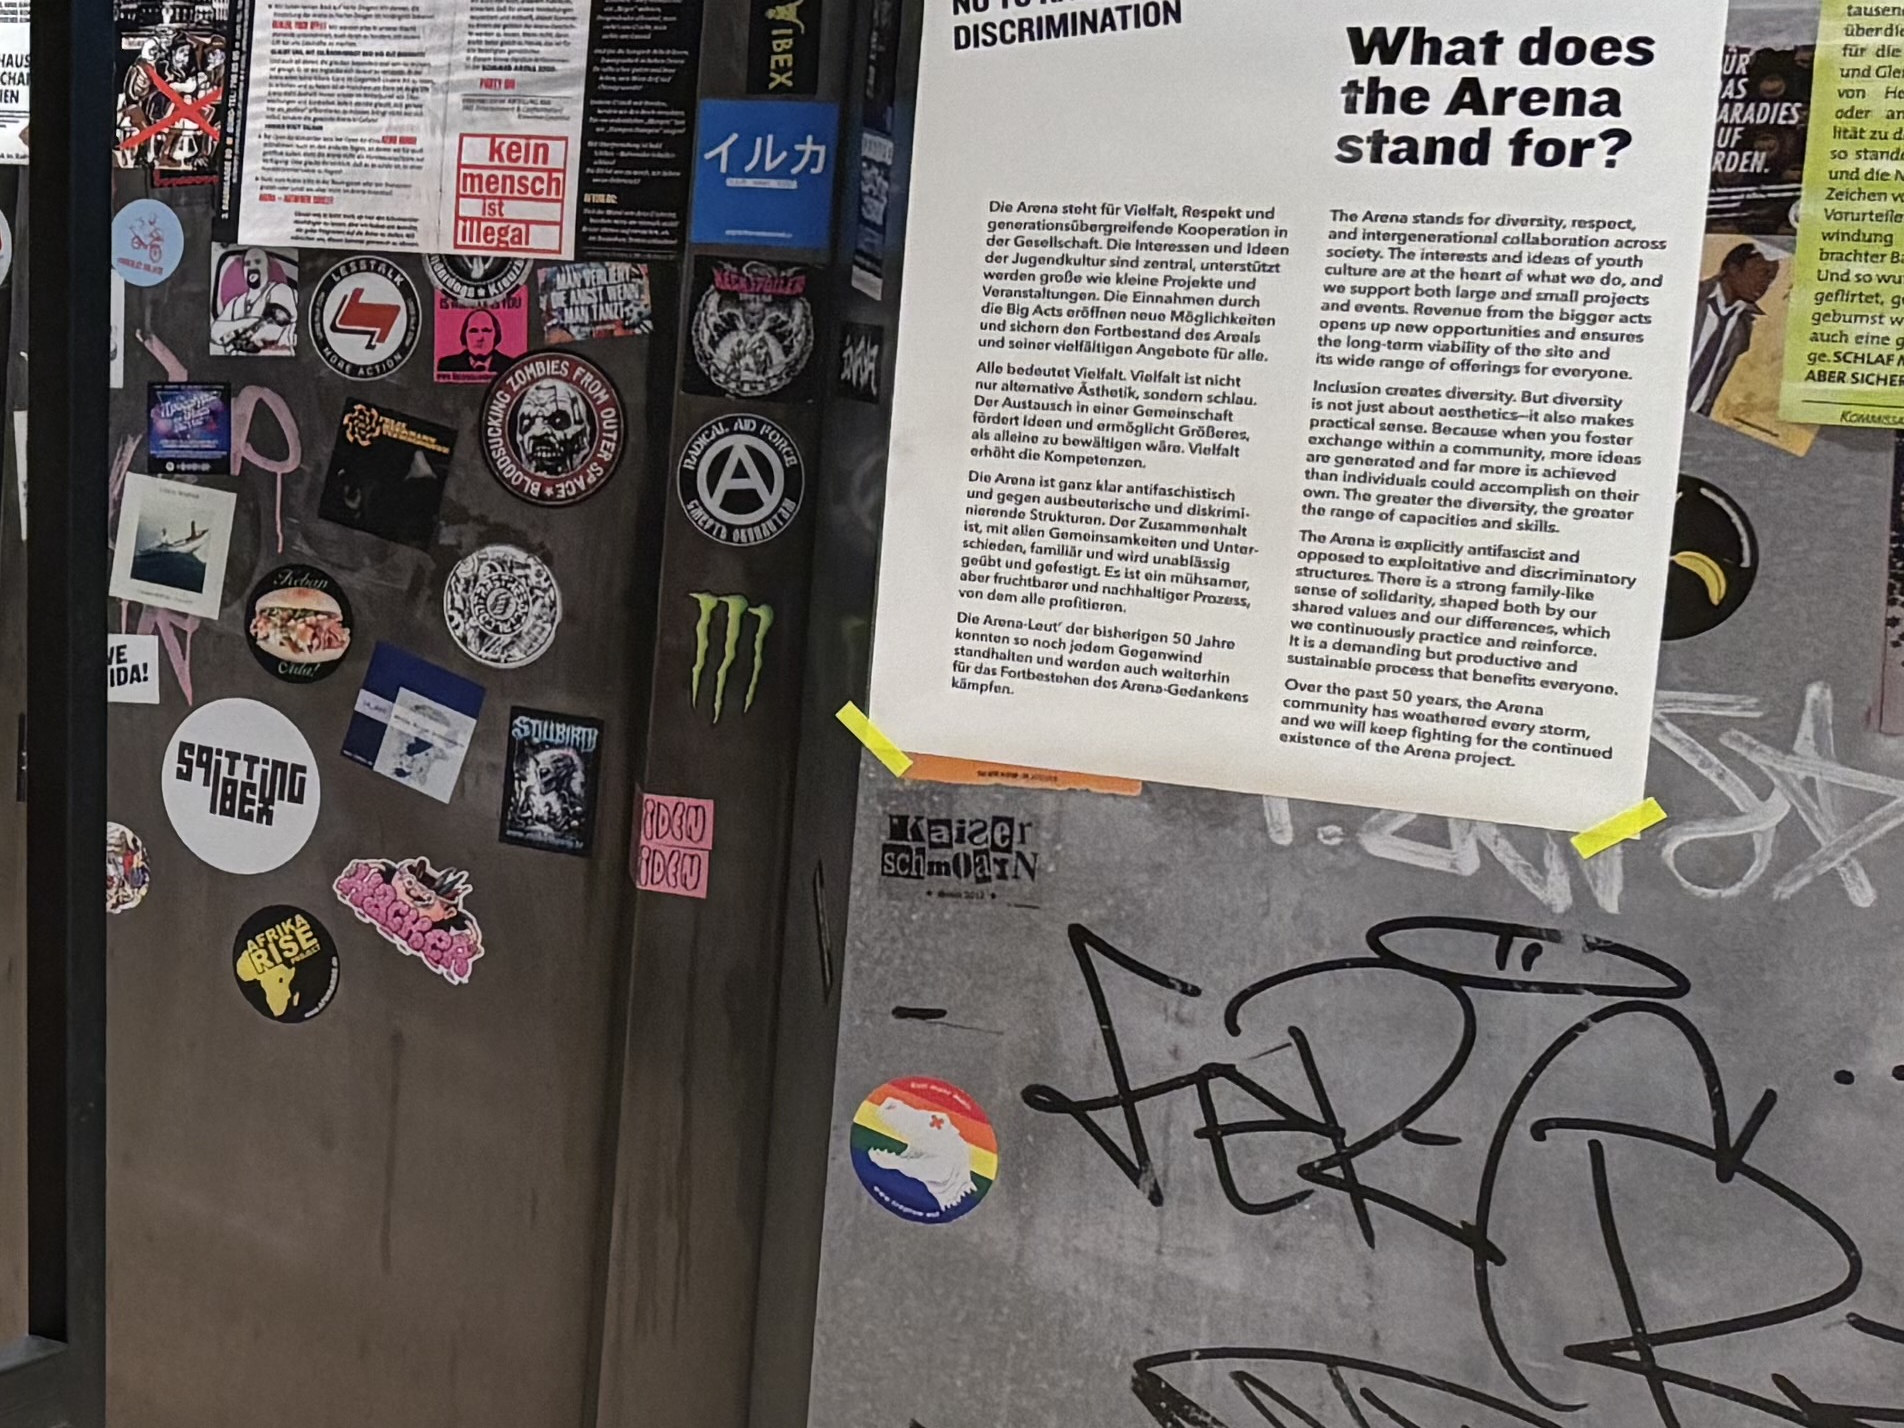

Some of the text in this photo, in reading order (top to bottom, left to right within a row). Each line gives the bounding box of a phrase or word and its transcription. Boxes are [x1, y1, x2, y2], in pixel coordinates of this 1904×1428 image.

[768, 28, 794, 90] IBEX
[1346, 26, 1656, 66] What does
[1341, 76, 1622, 117] the Arena
[489, 137, 549, 165] kein
[704, 132, 826, 174] イルカ
[1334, 127, 1633, 168] stand for?
[462, 170, 561, 196] mensch
[482, 200, 504, 216] ist
[1330, 209, 1636, 233] The Arena stands for diversity, respect,
[461, 221, 530, 247] illegal
[487, 359, 618, 499] BLOODSUCKING ZOMBIES FROM OUTER SPACE
[246, 914, 311, 953] AFRIKA
[250, 925, 318, 974] RISE
